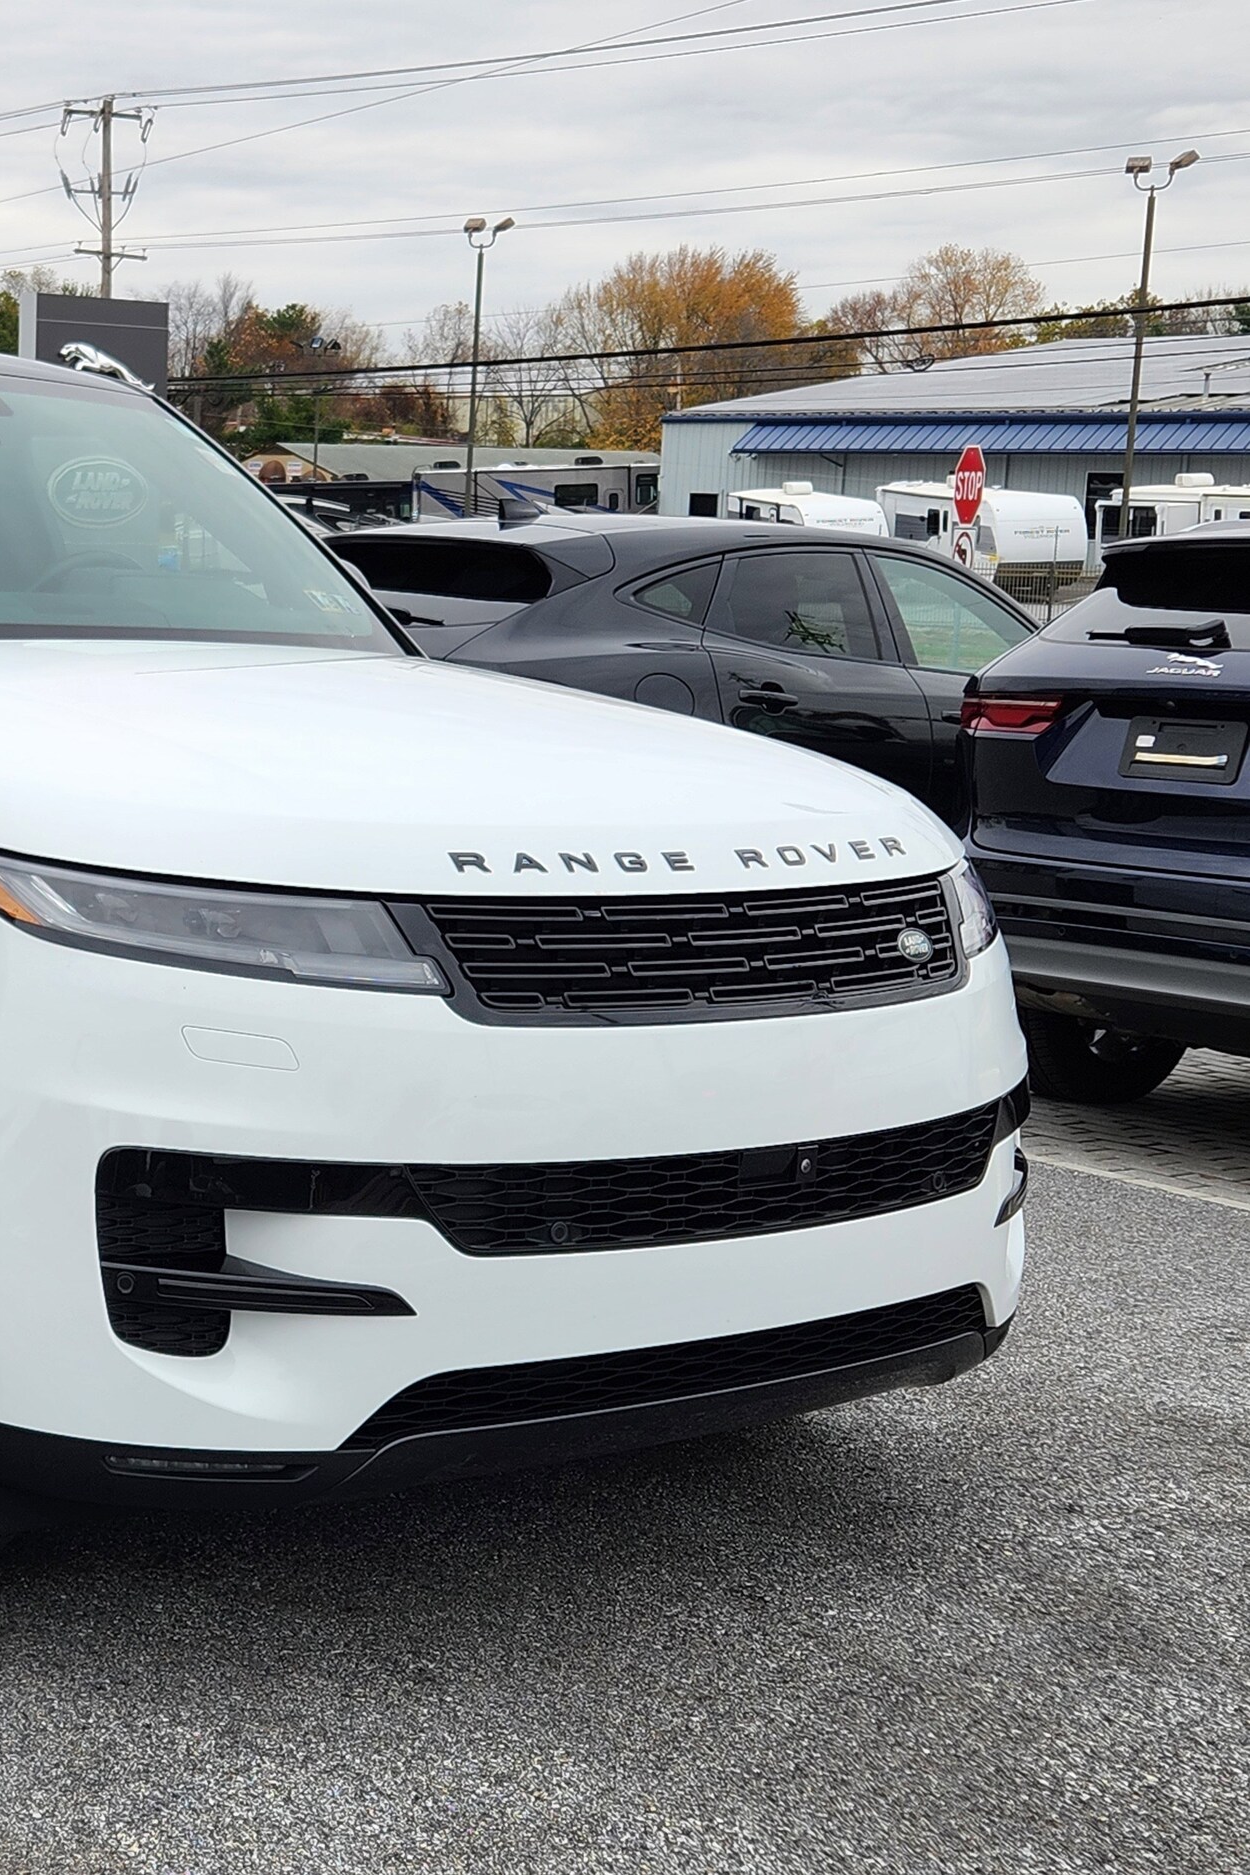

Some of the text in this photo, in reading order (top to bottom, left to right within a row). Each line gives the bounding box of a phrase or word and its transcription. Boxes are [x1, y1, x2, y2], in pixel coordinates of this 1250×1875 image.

[71, 471, 121, 491] LAND
[955, 471, 983, 500] STOP
[75, 491, 134, 510] ROVER
[1145, 667, 1222, 677] JAGUAR
[447, 836, 907, 875] RANGE ROVER
